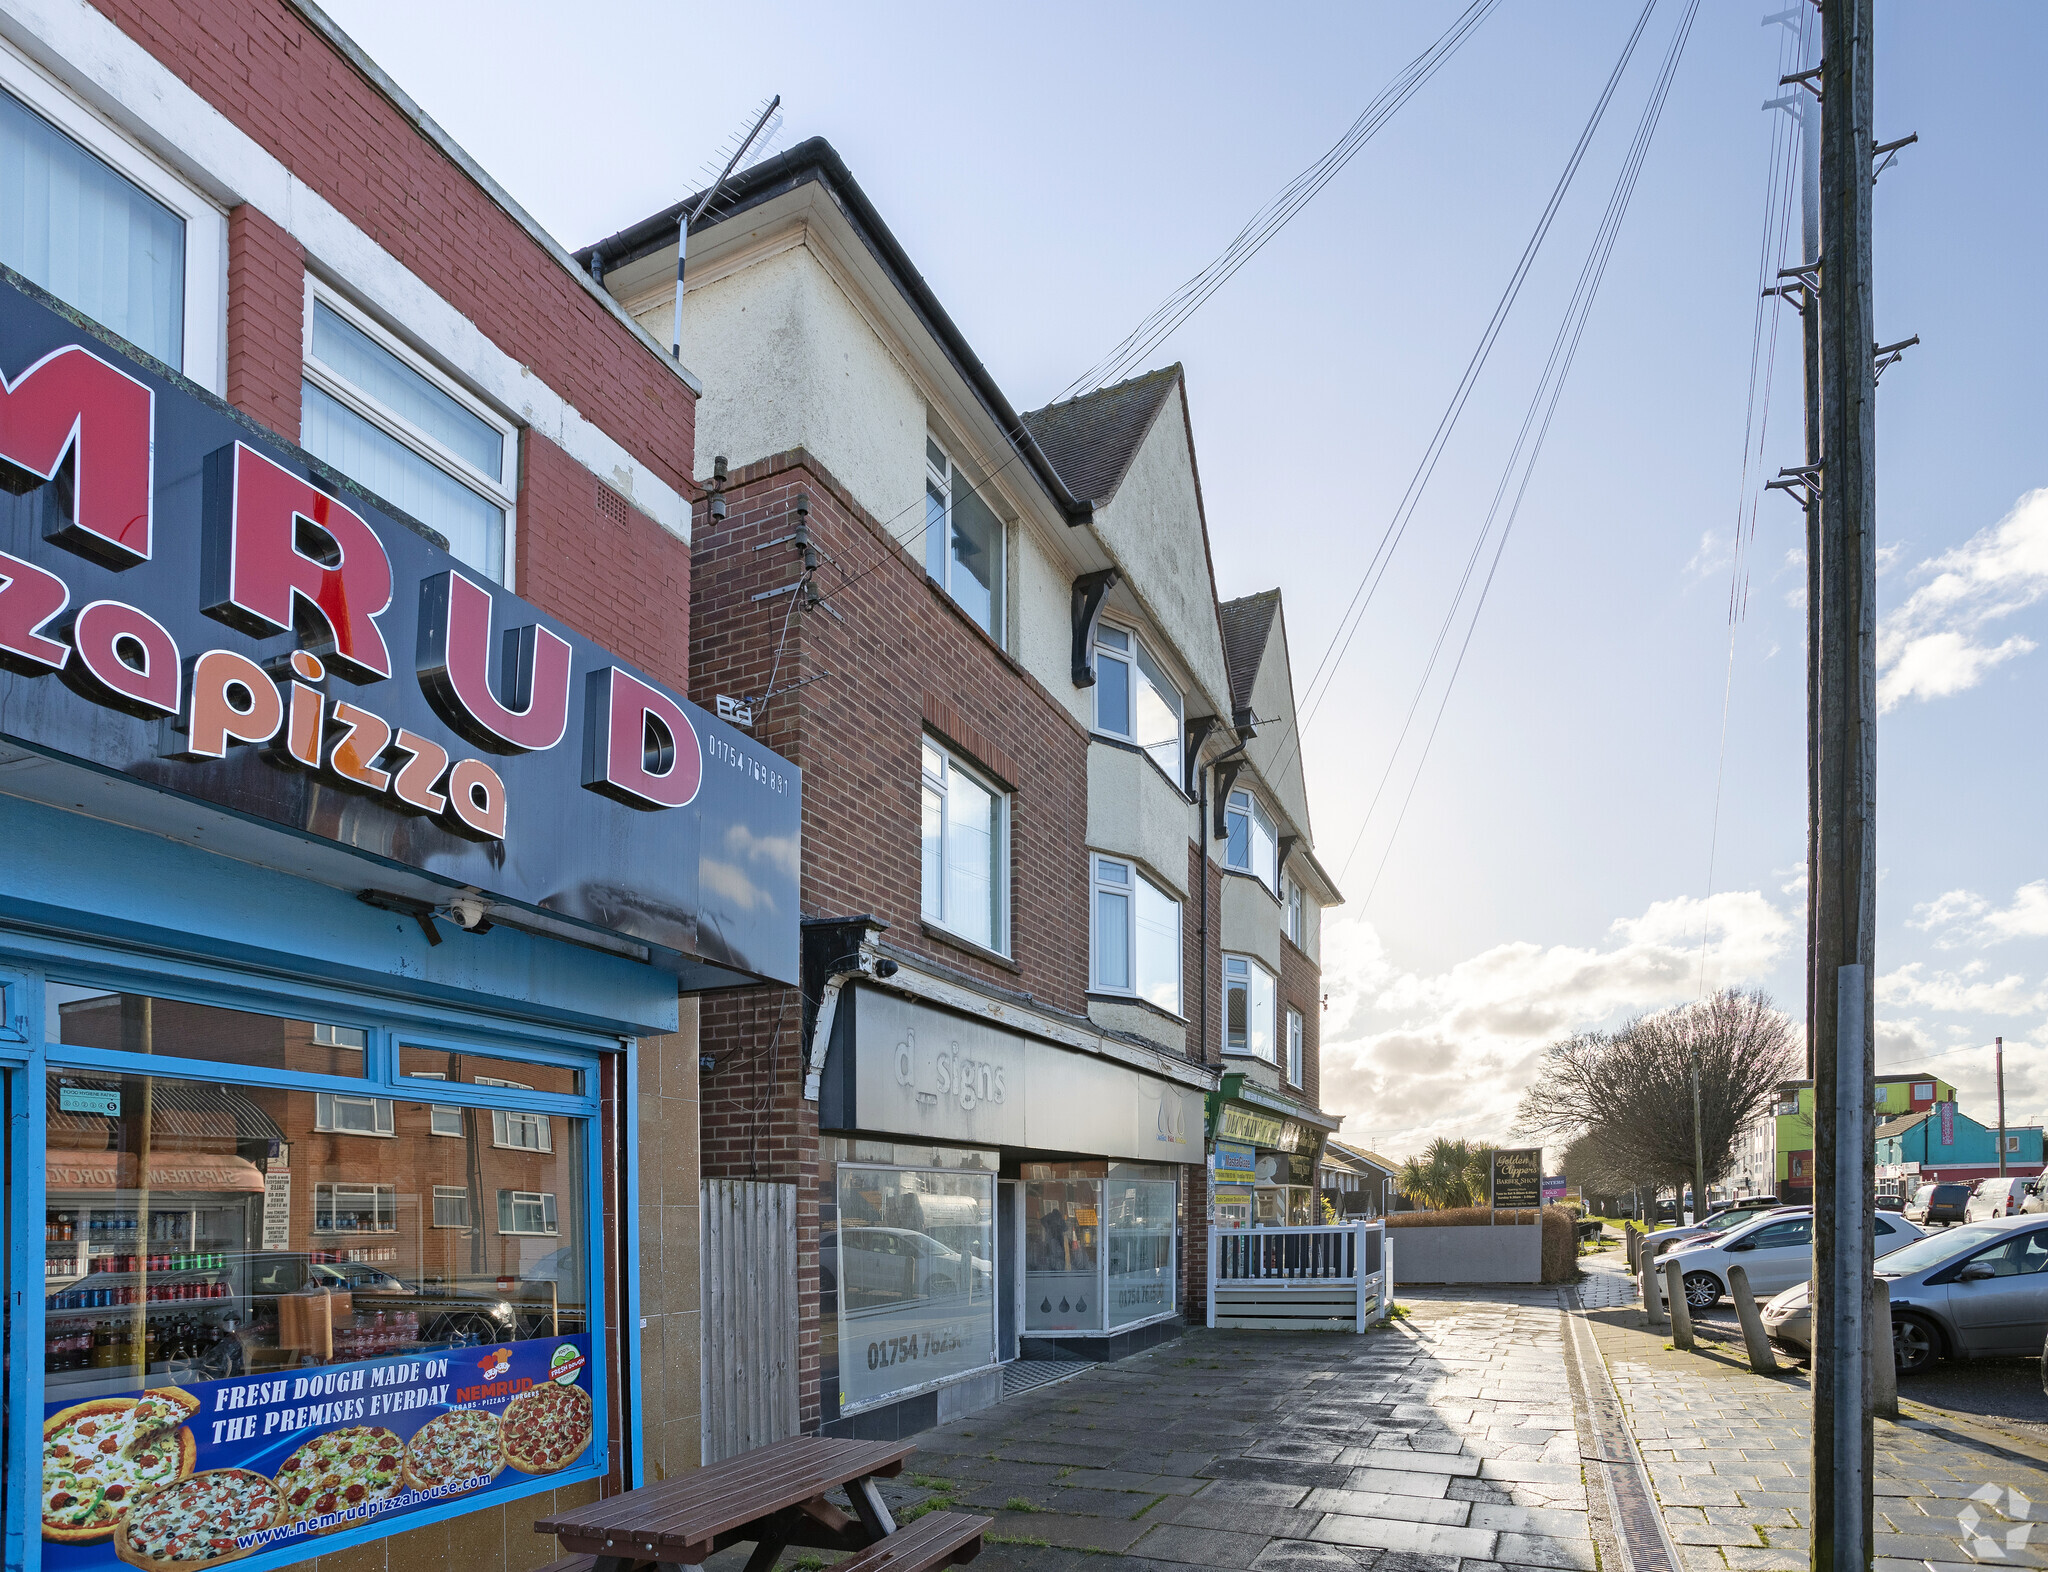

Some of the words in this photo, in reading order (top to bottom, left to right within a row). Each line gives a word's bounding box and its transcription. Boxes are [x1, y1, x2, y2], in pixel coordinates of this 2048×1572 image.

[709, 734, 744, 772] 01754
[747, 756, 767, 785] 769
[770, 770, 789, 798] 831
[1496, 1154, 1529, 1167] Golden
[1501, 1164, 1537, 1178] Clippers
[1496, 1177, 1521, 1186] BARBER
[867, 1334, 919, 1371] 01754
[921, 1325, 973, 1358] 7625
[551, 1364, 568, 1377] FRESH
[568, 1357, 585, 1369] DOUGH
[214, 1378, 289, 1412] FRESH
[291, 1365, 366, 1401] DOUGH
[370, 1359, 420, 1388] MADE
[427, 1358, 449, 1380] ON
[456, 1377, 534, 1404] NEMRUD
[212, 1414, 261, 1445] THE
[262, 1396, 365, 1436] PREMISES
[369, 1383, 450, 1417] EVERDAY
[448, 1401, 477, 1413] KEBABS
[482, 1396, 506, 1406] PIZZAS
[510, 1390, 540, 1401] BURGERS
[236, 1472, 492, 1549] www.nemrudpizzahouse.com
